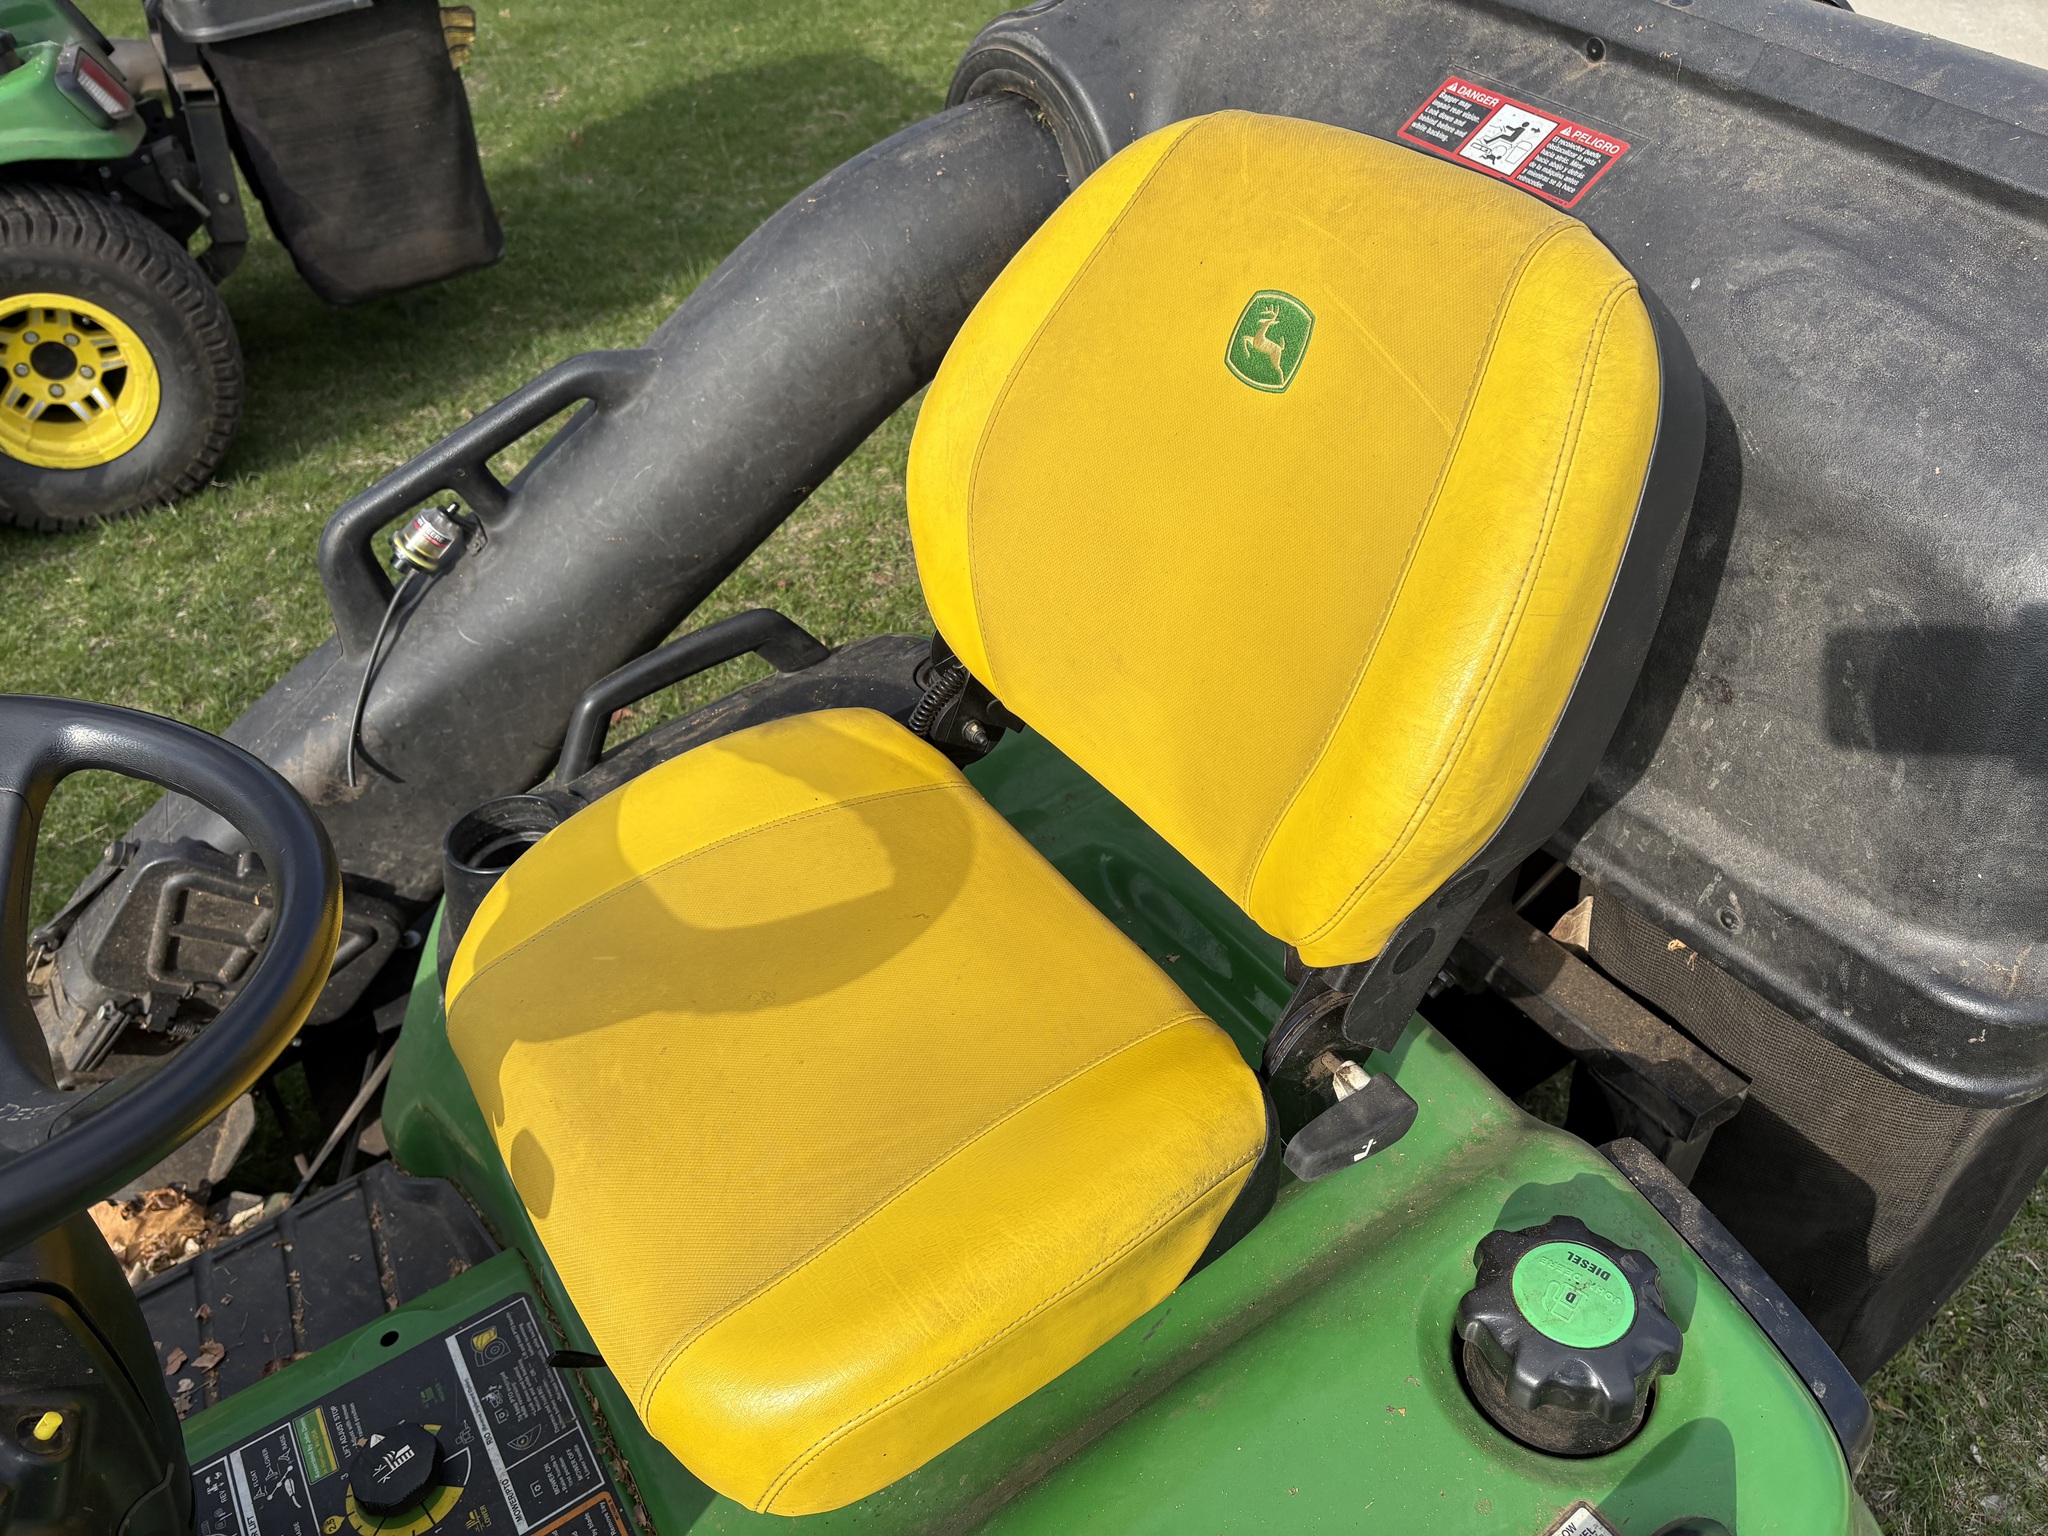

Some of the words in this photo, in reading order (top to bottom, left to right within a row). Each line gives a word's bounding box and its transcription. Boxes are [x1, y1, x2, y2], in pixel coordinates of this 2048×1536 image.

[1439, 92, 1459, 103] Bagger
[1458, 100, 1472, 109] may
[1458, 86, 1499, 106] DANGER
[1418, 114, 1438, 125] behind
[1437, 121, 1455, 133] before
[1425, 106, 1439, 116] Look
[1438, 112, 1454, 122] down
[1453, 119, 1466, 127] and
[1450, 107, 1463, 115] rear
[1462, 112, 1479, 123] vision.
[1412, 122, 1427, 131] while
[1426, 127, 1448, 141] backing.
[1558, 139, 1584, 152] recolector
[1583, 149, 1601, 159] puede
[1572, 131, 1619, 153] PELIGRO
[1541, 149, 1555, 158] hacia
[1555, 155, 1569, 164] atrás.
[1570, 160, 1585, 170] Mirar
[1547, 143, 1577, 158] obstaculizar
[1583, 158, 1596, 166] vista
[1535, 155, 1549, 164] hacia
[1549, 161, 1564, 170] abajo
[1568, 169, 1585, 179] detrás
[1542, 167, 1564, 179] máquina
[1564, 176, 1579, 185] antes
[1517, 175, 1543, 189] retroceder.
[1527, 170, 1549, 182] mientras
[1562, 184, 1575, 193] hace
[1539, 1256, 1583, 1282] DEERE
[1567, 1251, 1611, 1282] DIESEL
[1565, 1292, 1577, 1304] D
[331, 1406, 340, 1421] STOP
[350, 1403, 359, 1422] position
[518, 1414, 523, 1422] To
[355, 1422, 363, 1437] raised
[478, 1413, 488, 1431] (Reverse
[550, 1414, 559, 1433] Depress
[336, 1422, 347, 1444] ADJUST
[349, 1430, 359, 1446] Adjust
[484, 1432, 493, 1445] RIO
[307, 1444, 313, 1452] by
[342, 1445, 351, 1458] LIFT
[566, 1449, 574, 1459] OFF
[574, 1445, 583, 1461] handle
[262, 1448, 271, 1467] LOWER
[309, 1452, 320, 1478] Assembled
[559, 1457, 570, 1476] position
[544, 1463, 551, 1472] ON
[553, 1461, 561, 1477] handle
[571, 1459, 583, 1481] MOWER
[581, 1461, 590, 1476] Lower
[250, 1470, 259, 1487] FLOAT
[548, 1473, 560, 1495] MOWER
[559, 1477, 567, 1491] Raise
[219, 1490, 227, 1503] REV
[502, 1479, 522, 1522] MOWER/PTO
[247, 1516, 256, 1530] LIFT
[326, 1518, 336, 1532] 2.5
[480, 1505, 493, 1527] LOWER
[585, 1513, 594, 1529] blade
[604, 1514, 616, 1536] Remove
[293, 1522, 302, 1536] AISE
[1561, 1521, 1577, 1536] OW
